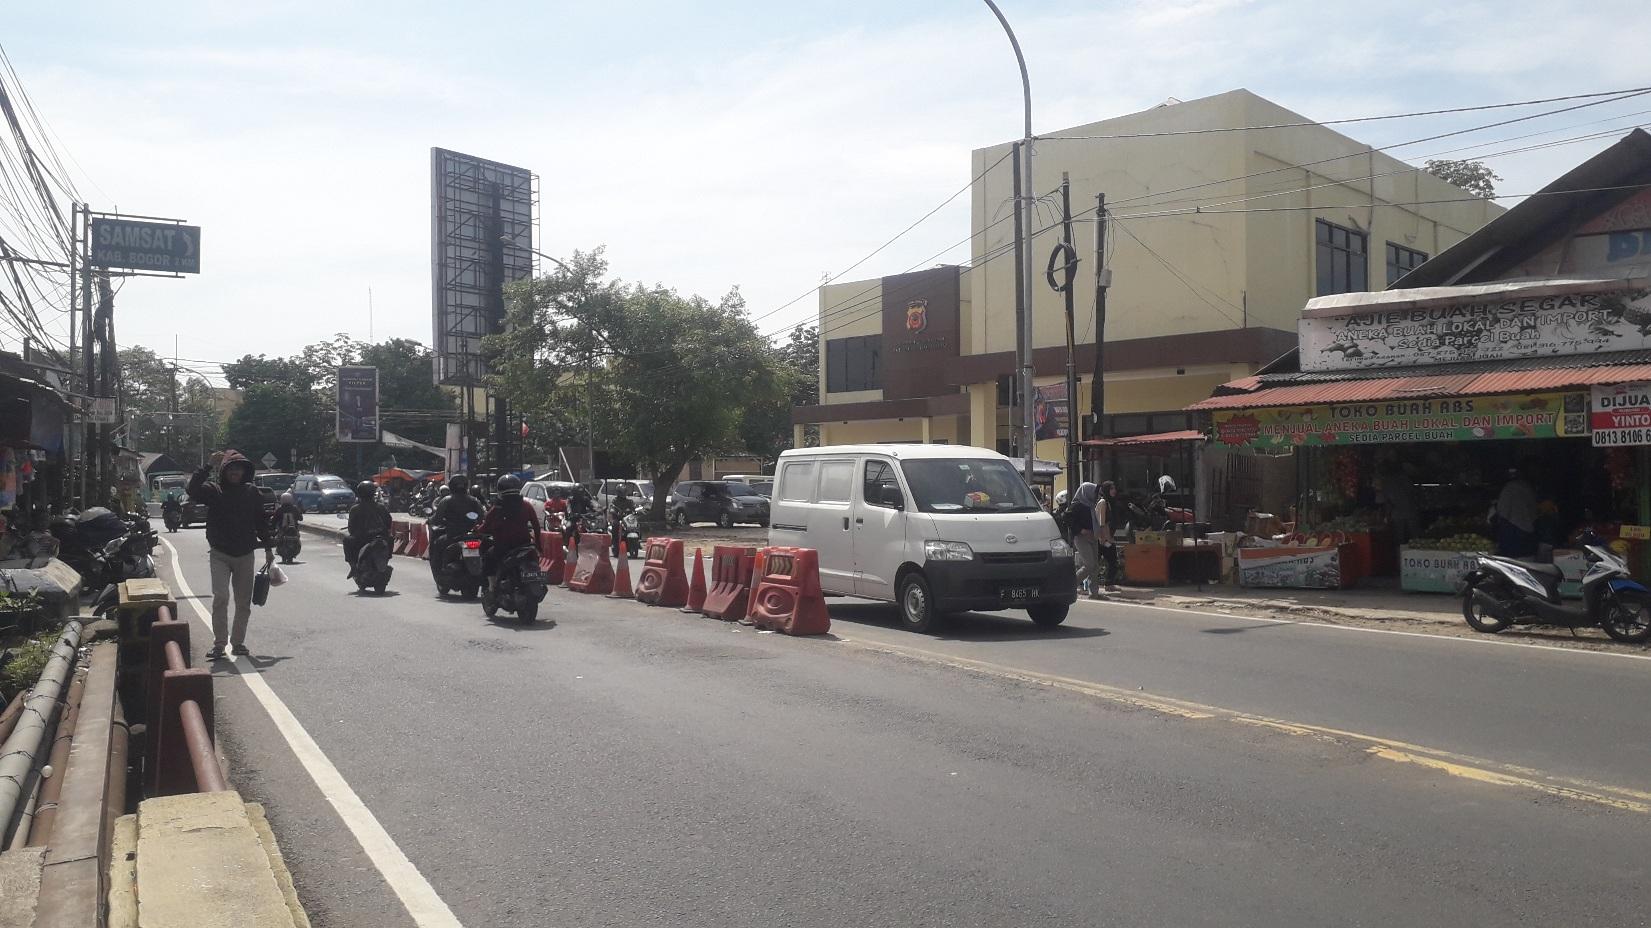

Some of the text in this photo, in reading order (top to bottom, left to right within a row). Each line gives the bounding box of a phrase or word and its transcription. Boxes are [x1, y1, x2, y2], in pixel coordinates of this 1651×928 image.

[101, 224, 175, 250] SAMSAT
[130, 252, 170, 266] BOGOR
[1410, 303, 1488, 322] BUAH
[1500, 294, 1600, 314] SEGAR
[1336, 309, 1612, 342] ANEKA BUAH LOKAL DAN IMPORT
[1400, 329, 1540, 350] Sedia Parcel Buah
[1330, 400, 1474, 418] TOKO BUAH ABS
[1263, 423, 1322, 435] MENJUAL
[1325, 421, 1369, 432] ANEKA
[1373, 419, 1409, 430] BUAH
[1413, 417, 1457, 429] LOKAL
[1463, 415, 1491, 427] DAN
[1496, 413, 1555, 426] IMPORT
[1350, 430, 1453, 442] SEDIA PARCEL BUAH
[1595, 430, 1618, 444] 0813
[1620, 429, 1643, 442] 8106
[1404, 558, 1430, 568] TOKO
